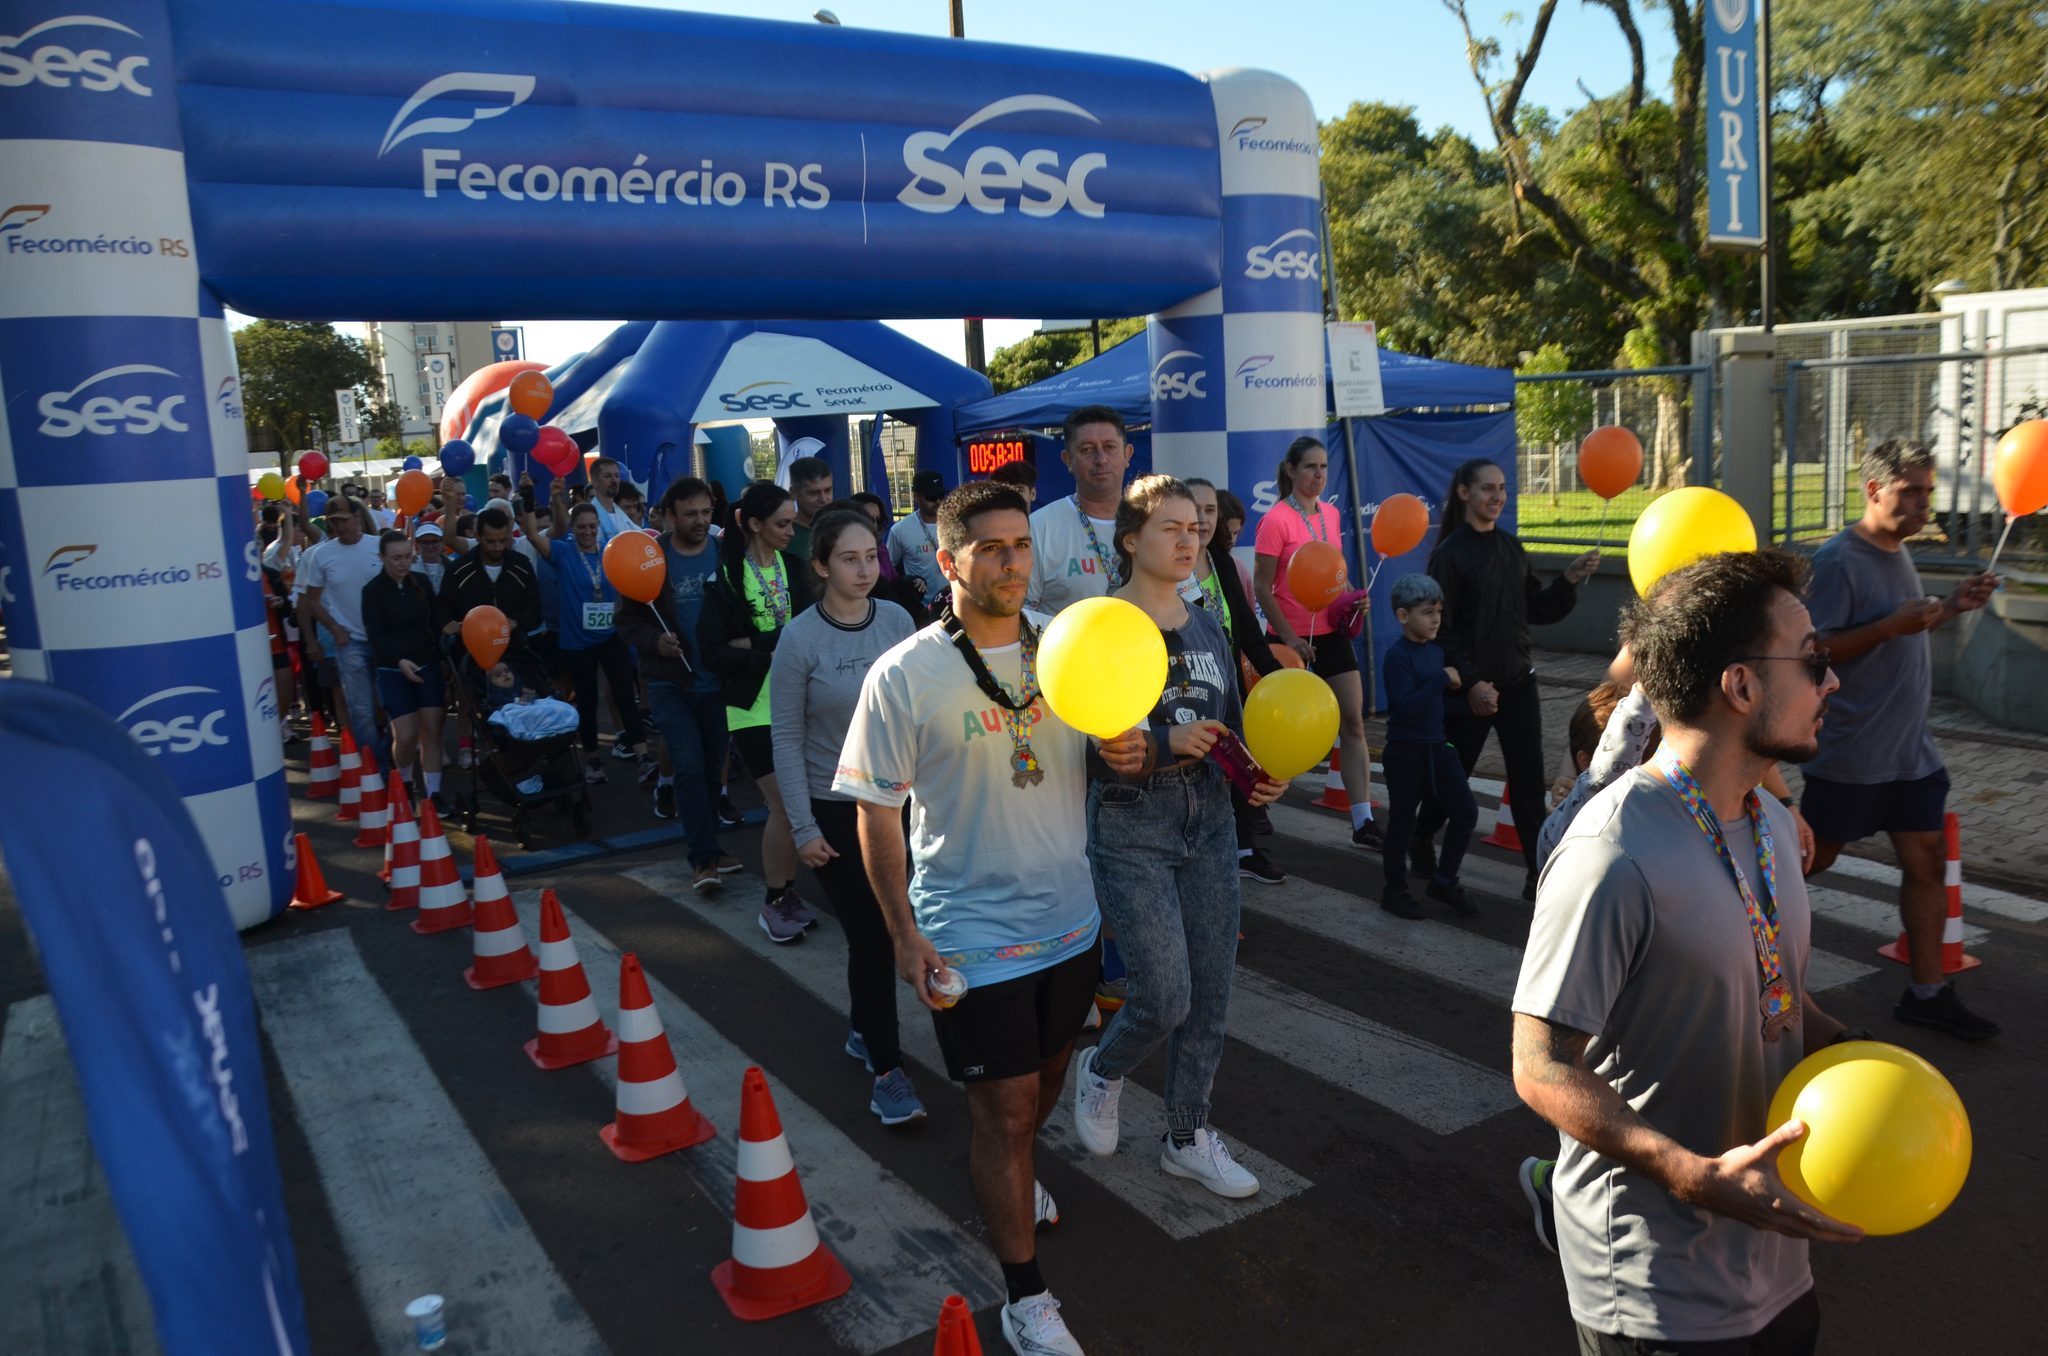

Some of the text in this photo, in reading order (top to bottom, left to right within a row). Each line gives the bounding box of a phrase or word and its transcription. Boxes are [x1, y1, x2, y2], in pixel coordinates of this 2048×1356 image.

[897, 112, 1107, 219] Sesc
[1717, 45, 1748, 232] URI
[422, 147, 831, 211] Fecomércio RS
[7, 235, 190, 258] Fecomércio RS
[38, 378, 189, 438] Sesc
[719, 387, 811, 412] Sesc
[56, 562, 223, 591] Fecomércio RS
